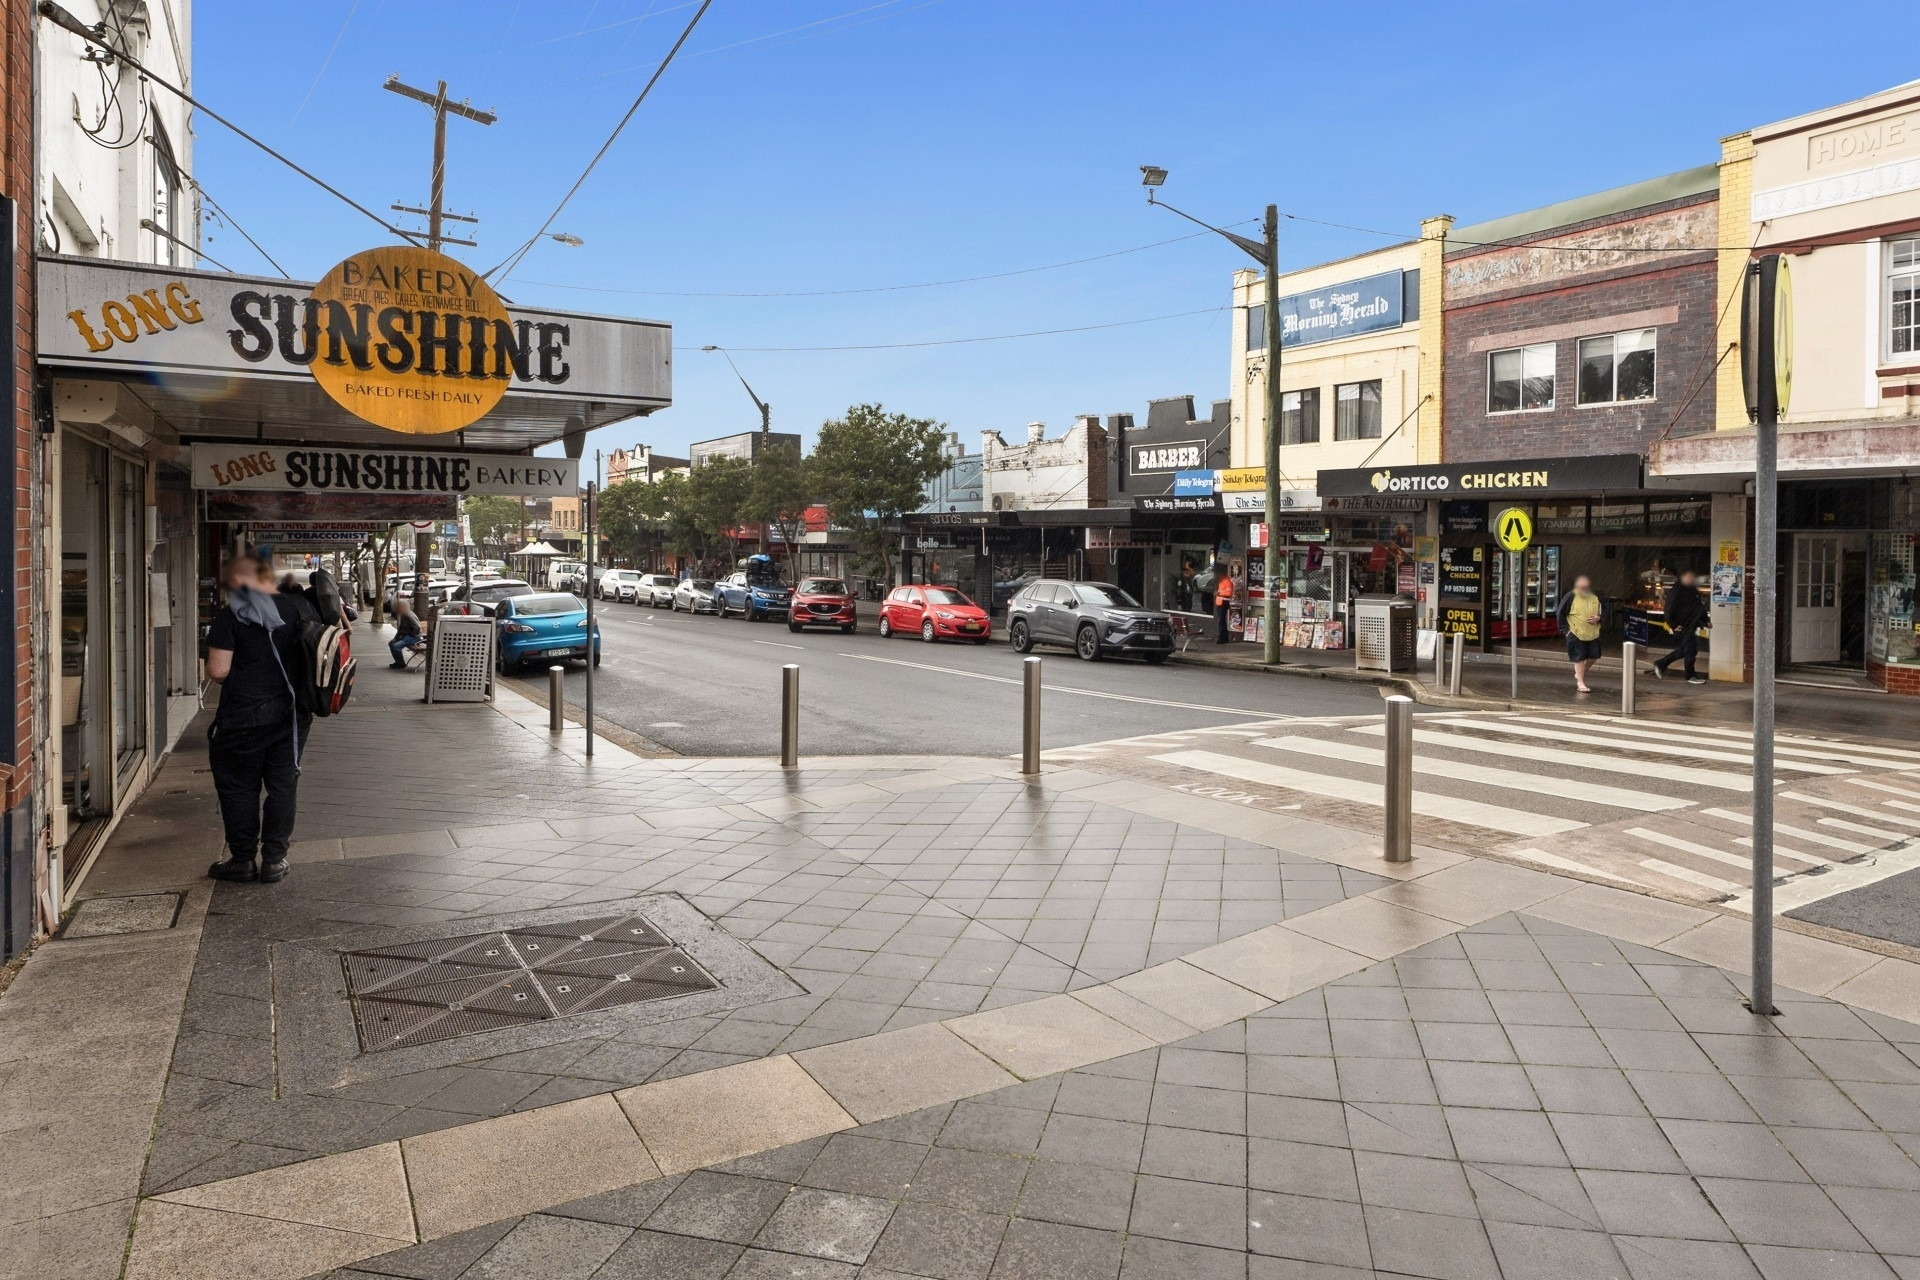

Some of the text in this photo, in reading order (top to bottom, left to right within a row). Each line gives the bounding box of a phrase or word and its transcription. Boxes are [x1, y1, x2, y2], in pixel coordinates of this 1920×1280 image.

[1816, 120, 1906, 164] HOME
[343, 260, 481, 298] BAKERY
[343, 287, 367, 303] BREAD
[374, 291, 389, 304] PIES
[421, 294, 462, 312] VIETNAMESE
[1308, 291, 1359, 310] The Sydney
[1282, 295, 1389, 338] Morning Herald
[67, 281, 571, 384] LONG SUNSHINE
[345, 383, 483, 405] BAKED FRESH DAILY
[1138, 446, 1200, 470] BARBER
[210, 450, 568, 492] LONG SUNSHINE BAKERY
[1222, 473, 1243, 486] Sunday
[1460, 471, 1549, 489] CHICKEN
[1143, 497, 1215, 510] The Sydney Morning Herald
[1235, 496, 1250, 509] The
[1342, 496, 1420, 510] THE AUSTRALIAN
[1282, 519, 1320, 527] PENSHURST
[287, 532, 366, 540] TOBACCONIST
[917, 538, 939, 548] belle
[1447, 609, 1475, 622] OPEN
[1444, 621, 1478, 634] 7 DAYS
[1170, 783, 1272, 804] LOOK
